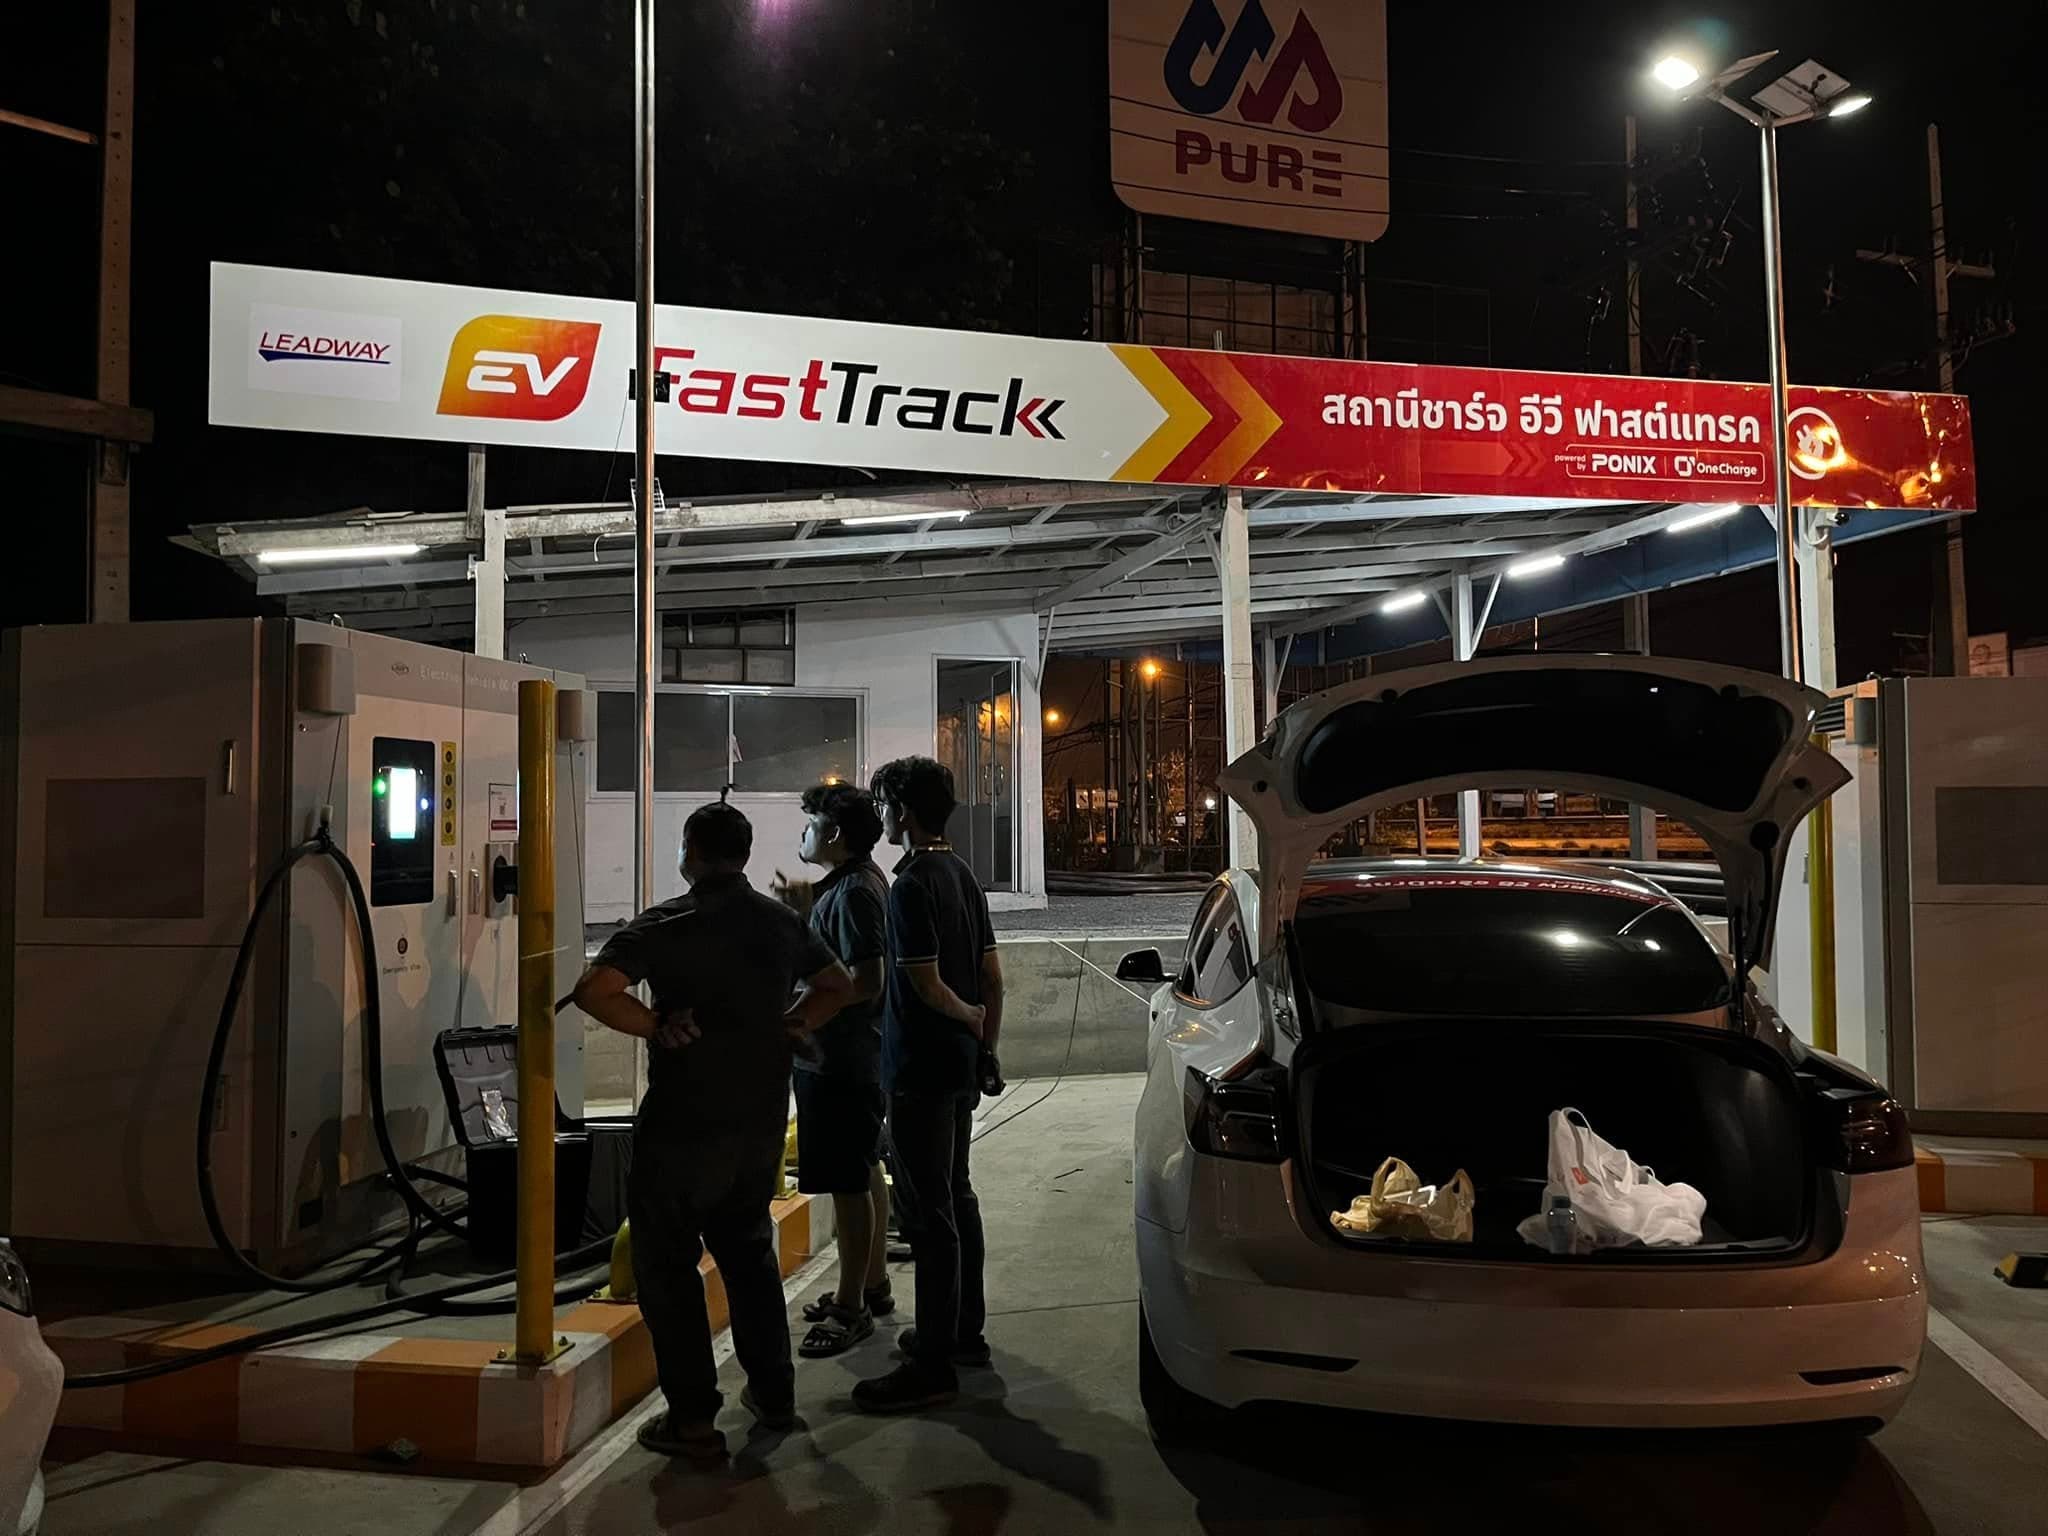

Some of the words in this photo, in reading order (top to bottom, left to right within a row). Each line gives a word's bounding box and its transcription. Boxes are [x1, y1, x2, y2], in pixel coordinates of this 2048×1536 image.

[1175, 128, 1342, 198] PURE
[259, 331, 391, 361] LEADWAY
[465, 349, 580, 396] EV
[1321, 387, 1508, 432] สถานีชาร์จ
[1519, 393, 1563, 435] อีวี
[1574, 399, 1761, 444] ฟาสต์แทรค
[1554, 454, 1587, 464] powered
[1576, 462, 1587, 471] by
[1591, 453, 1657, 475] PONIX
[1696, 462, 1758, 477] OneCharge
